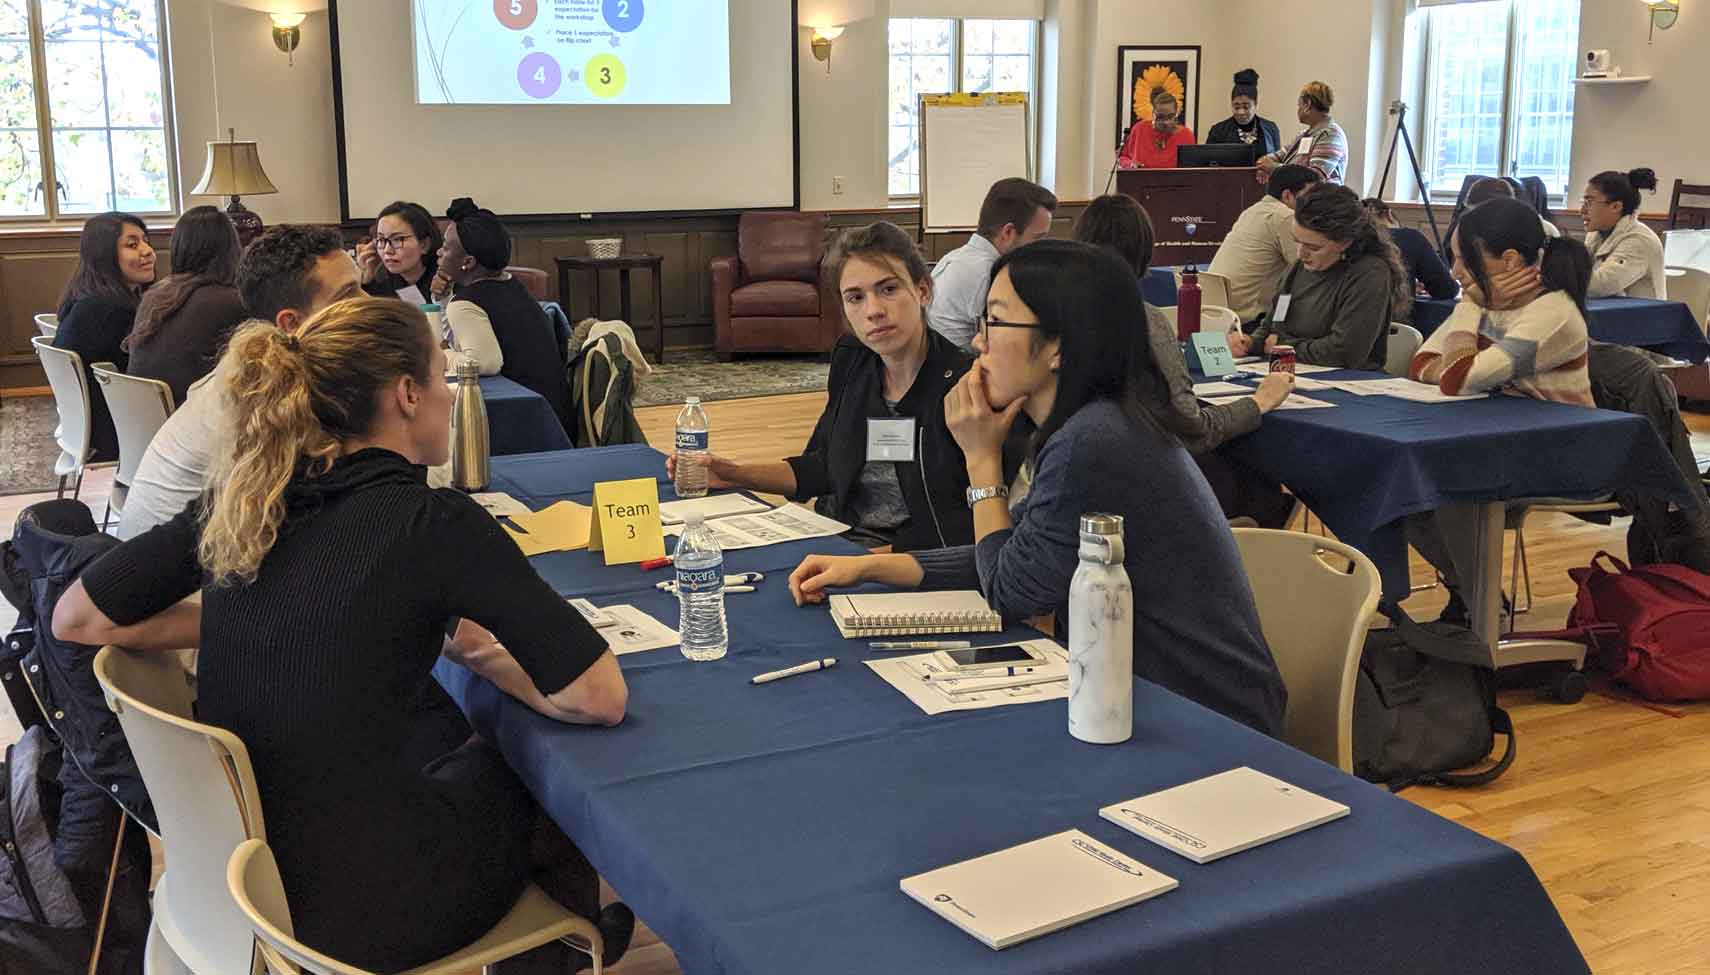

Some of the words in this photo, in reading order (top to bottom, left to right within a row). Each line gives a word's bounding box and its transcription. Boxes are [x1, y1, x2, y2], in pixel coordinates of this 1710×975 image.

[510, 0, 522, 15] 5
[616, 0, 629, 18] 2
[535, 66, 546, 84] 4
[600, 67, 611, 85] 3
[1200, 345, 1227, 355] Team
[603, 504, 650, 519] Team
[626, 524, 636, 540] 3
